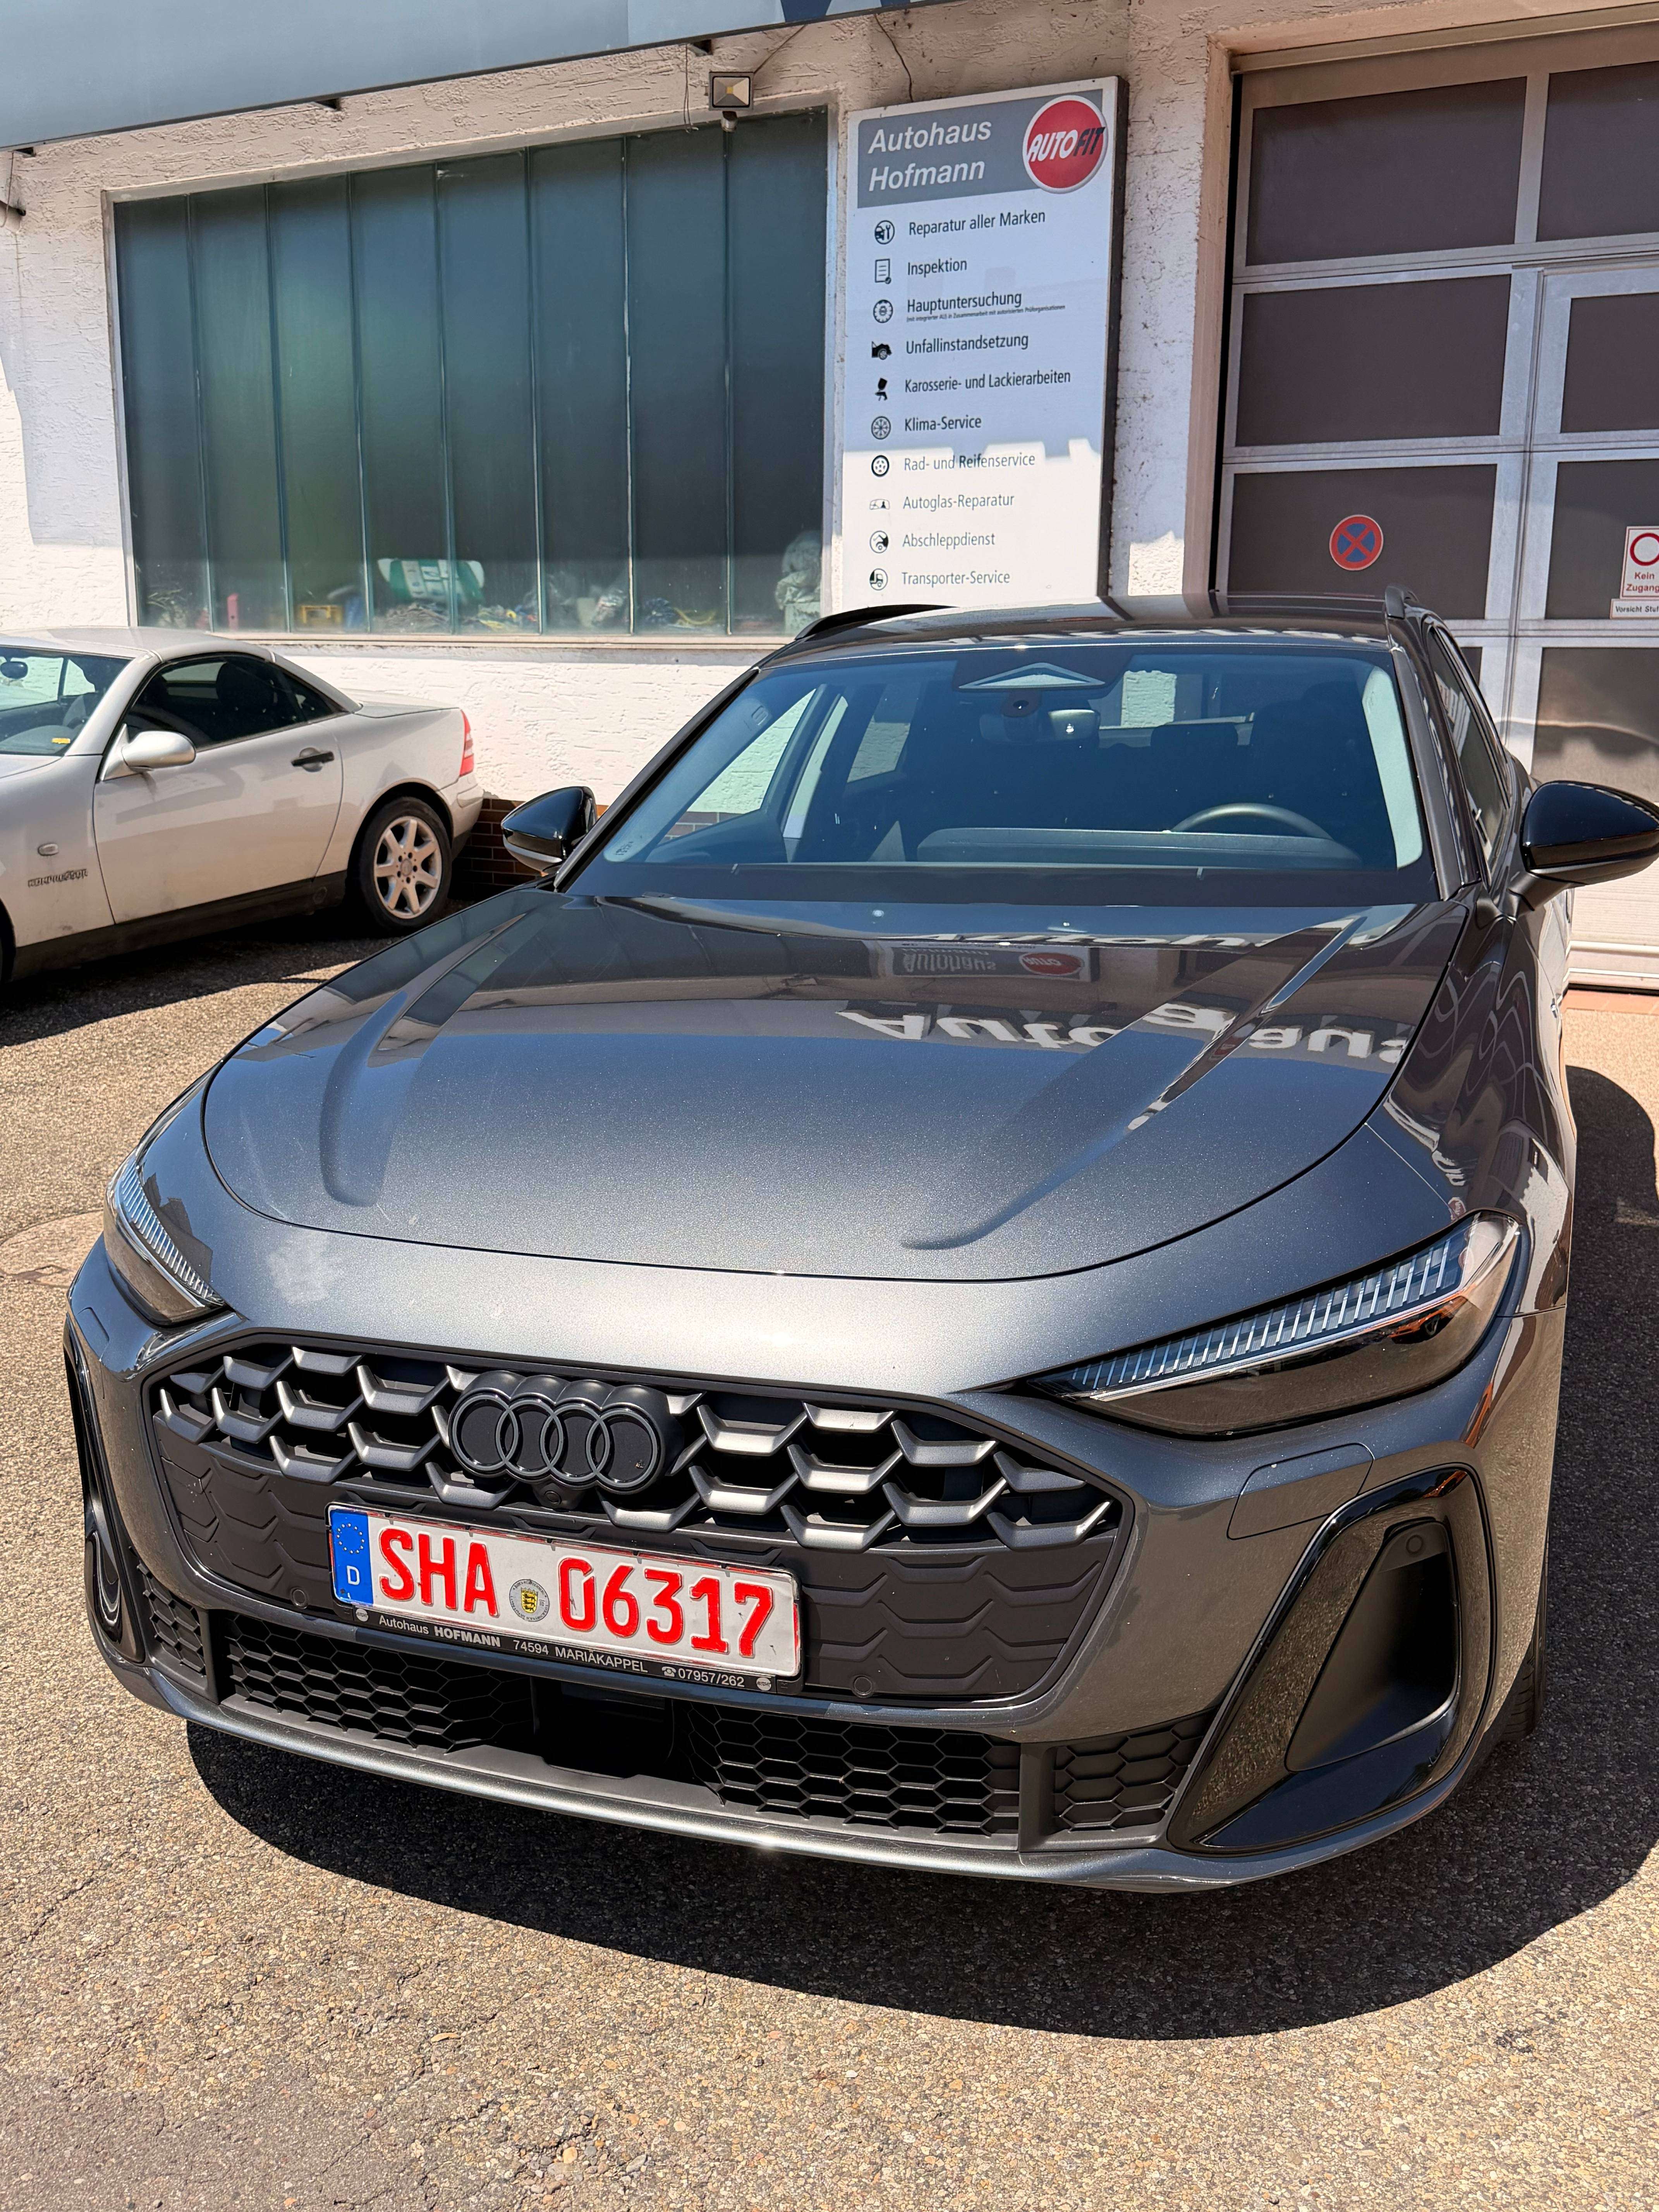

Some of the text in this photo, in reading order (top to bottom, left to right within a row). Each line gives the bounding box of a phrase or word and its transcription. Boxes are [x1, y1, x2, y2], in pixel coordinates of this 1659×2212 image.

[868, 121, 992, 154] Autohaus
[1027, 127, 1106, 163] AUTOFIT
[869, 160, 985, 192] Hofmann
[909, 210, 1046, 238] Reparatur aller Marken
[907, 258, 967, 278] Inspektion
[907, 291, 1022, 314] Hauptuntersuchung
[906, 334, 1029, 354] Unfallinstandsetzung
[905, 370, 1071, 393] Karosserie- und Lackierarbeiten
[905, 415, 982, 431] Klima-Service
[904, 453, 1035, 471] Rad- und Reifenservice
[903, 494, 1015, 512] Autoglas-Reparatur
[902, 533, 995, 550] Abschleppdienst
[902, 570, 1010, 587] Transporter-Service
[1626, 583, 1659, 593] Zugang
[347, 1565, 361, 1585] D
[378, 1528, 501, 1618] SHA
[558, 1557, 775, 1658] 06317
[379, 1614, 745, 1688] Autohaus HOFMANN 74594 MARIÄKAPPEL 07957/262
